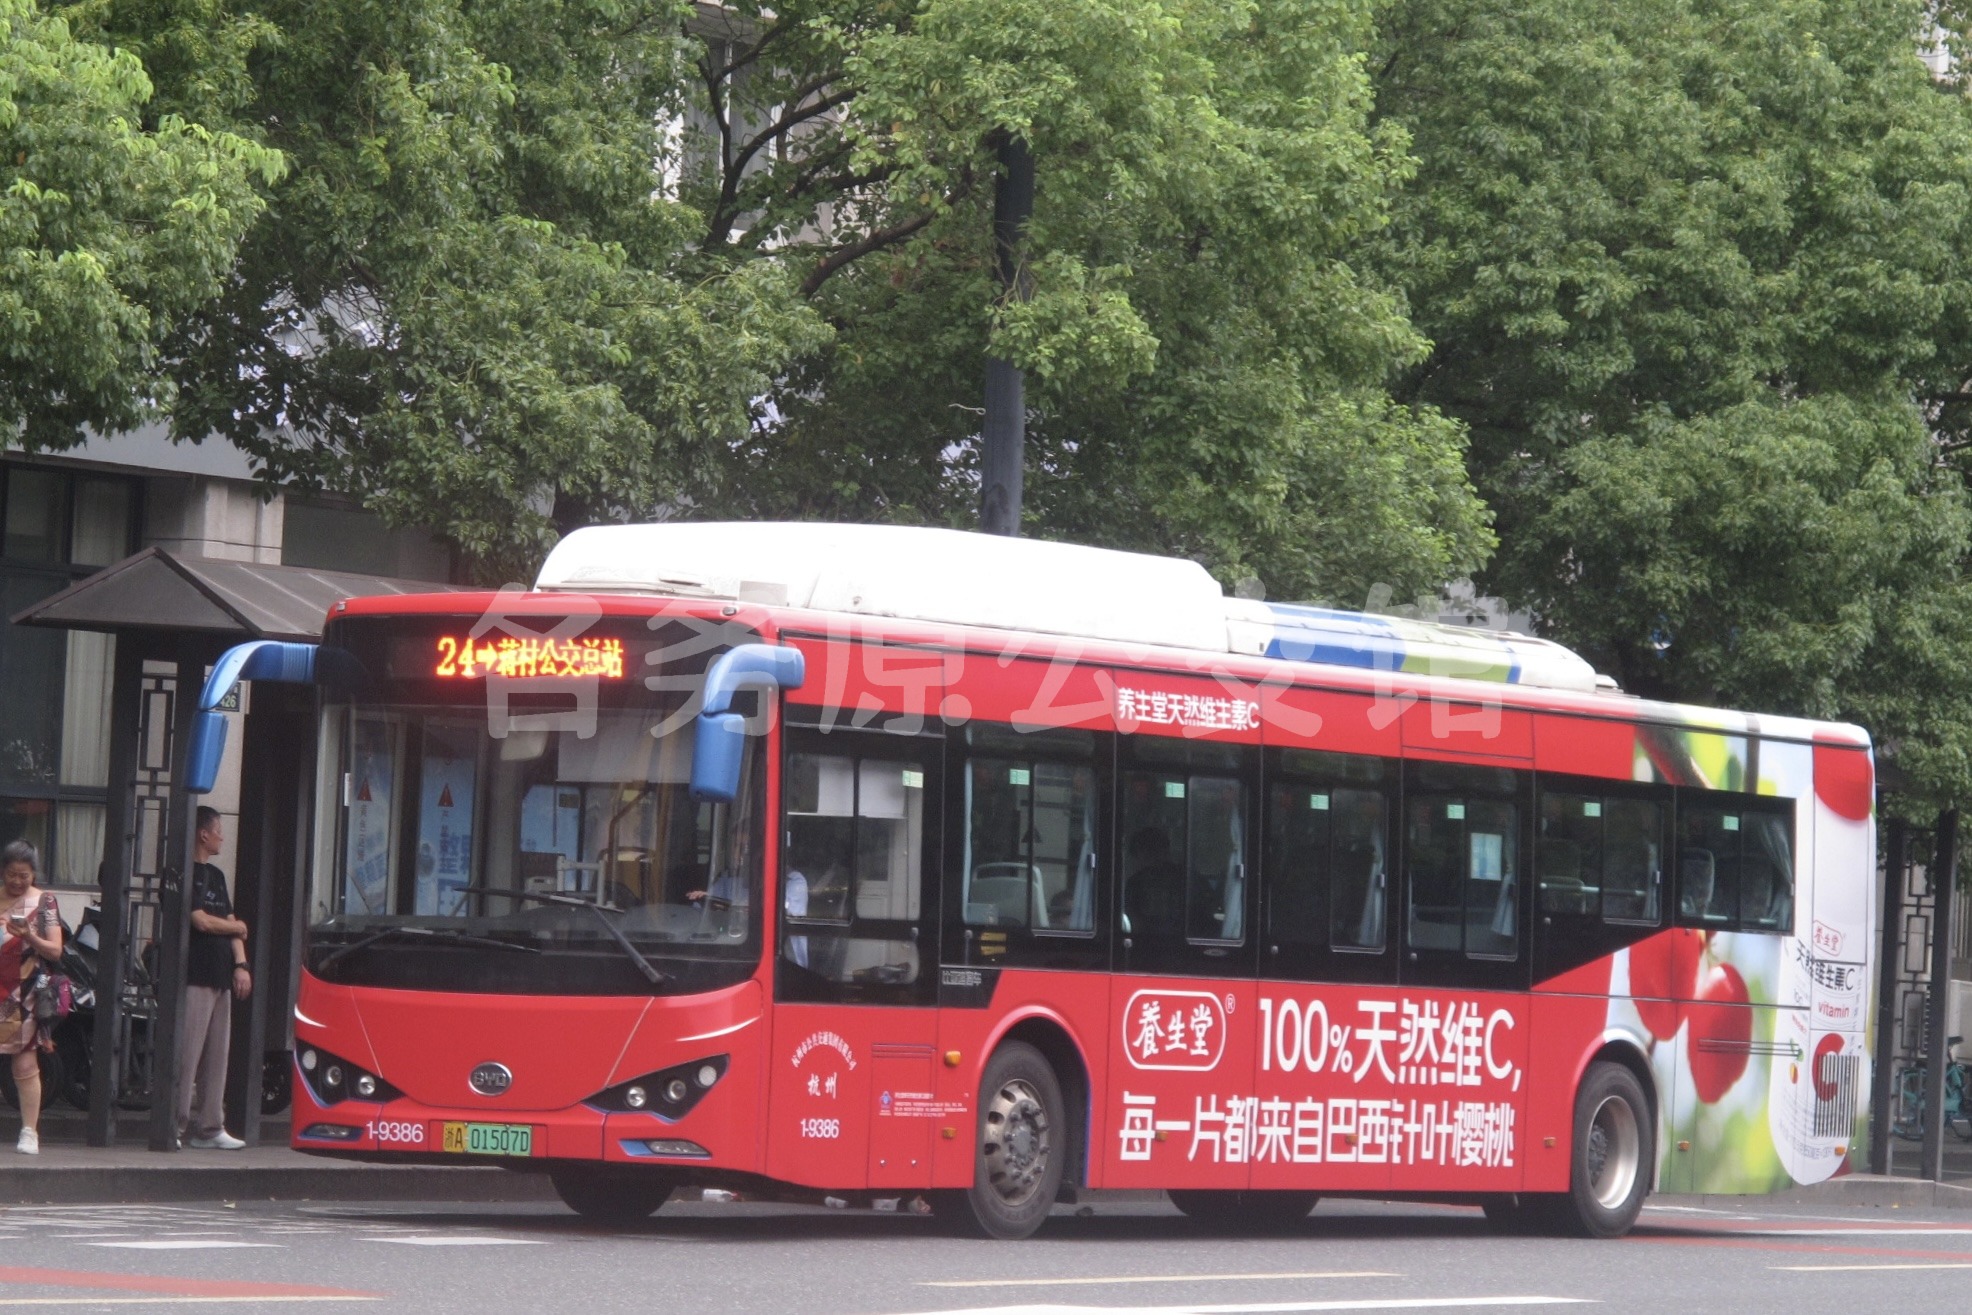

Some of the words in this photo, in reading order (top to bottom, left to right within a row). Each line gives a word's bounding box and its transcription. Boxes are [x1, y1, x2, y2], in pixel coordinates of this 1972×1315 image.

[436, 637, 476, 677] 24
[1118, 687, 1260, 731] 养生堂天然维生素C
[1818, 1001, 1850, 1018] vitamin
[473, 1071, 507, 1088] BYD
[807, 1071, 838, 1100] 杭州
[365, 1120, 424, 1144] 1-9386
[800, 1117, 840, 1139] 1-9386
[1118, 1091, 1516, 1168] 每一片都来自巴西针叶樱桃
